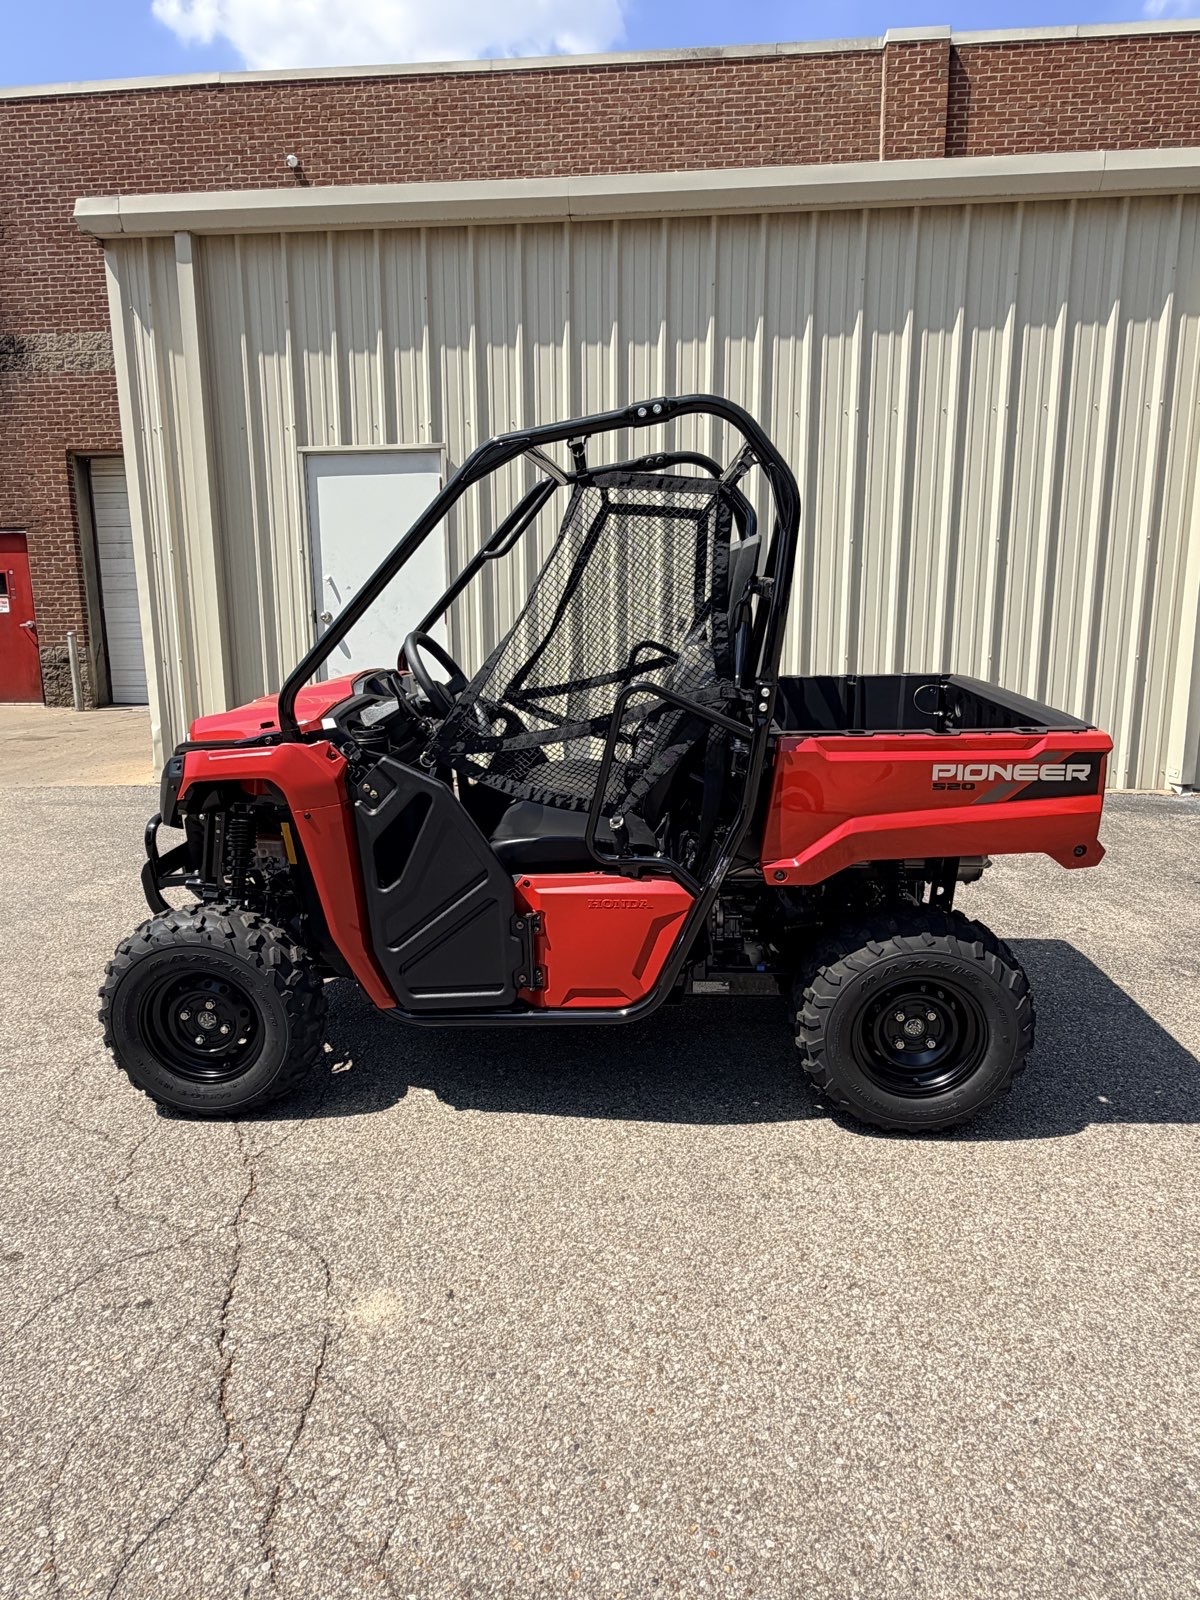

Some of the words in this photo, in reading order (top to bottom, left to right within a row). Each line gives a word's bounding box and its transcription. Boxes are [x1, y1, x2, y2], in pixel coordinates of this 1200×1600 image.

[932, 764, 1091, 781] PIONEER
[932, 783, 975, 791] 520
[587, 899, 654, 909] HONDA
[859, 959, 983, 993] MAXXIS
